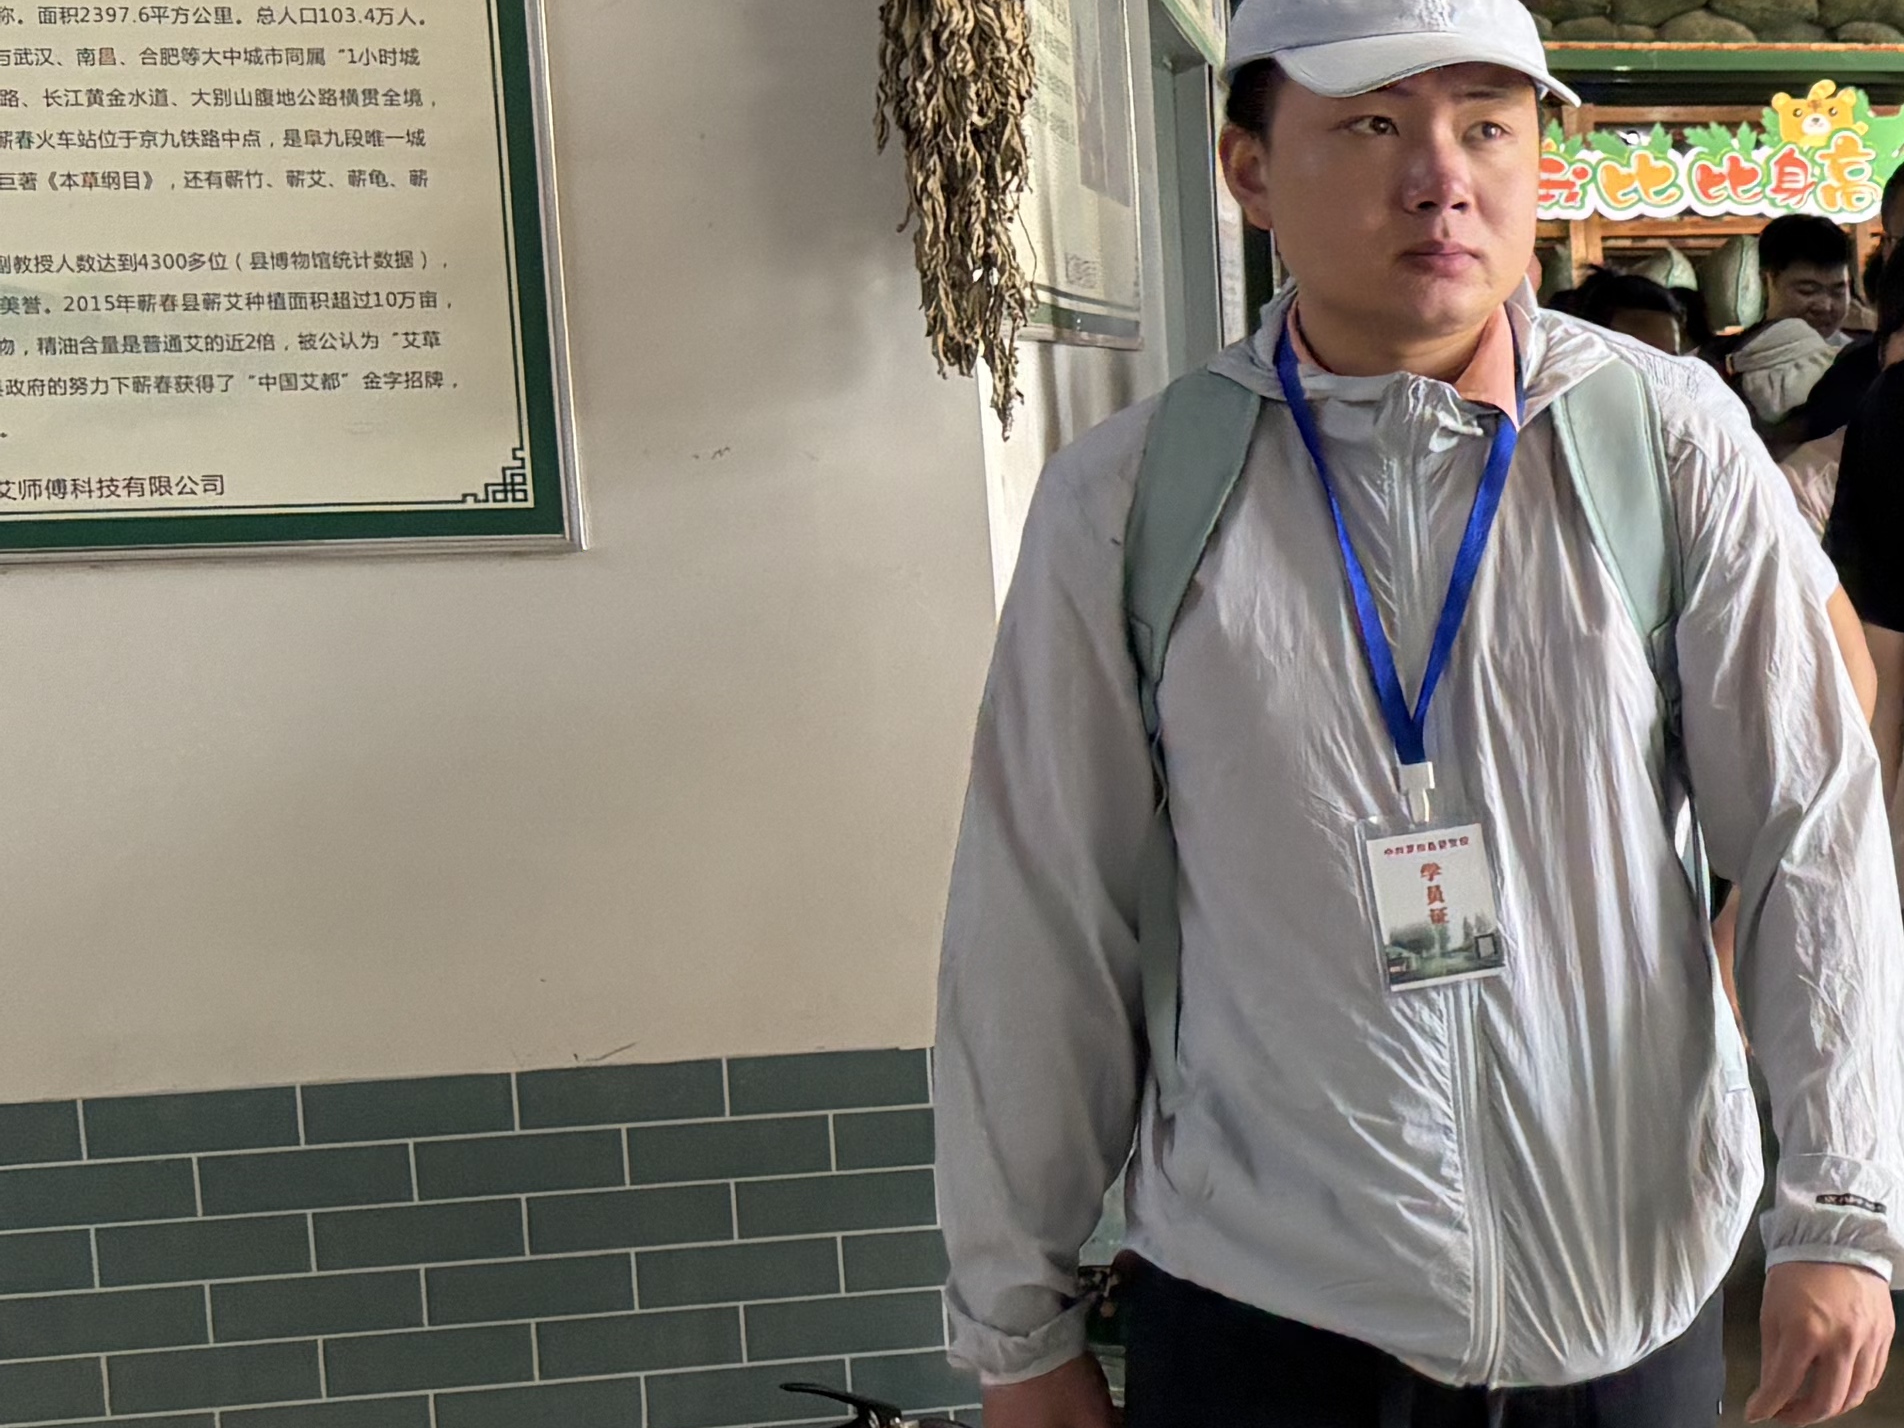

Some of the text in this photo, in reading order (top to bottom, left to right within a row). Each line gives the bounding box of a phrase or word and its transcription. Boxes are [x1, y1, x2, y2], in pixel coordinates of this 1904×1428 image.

[0, 371, 458, 396] 政府的努力下蕲春获得了“中国艾都”金字招牌，
